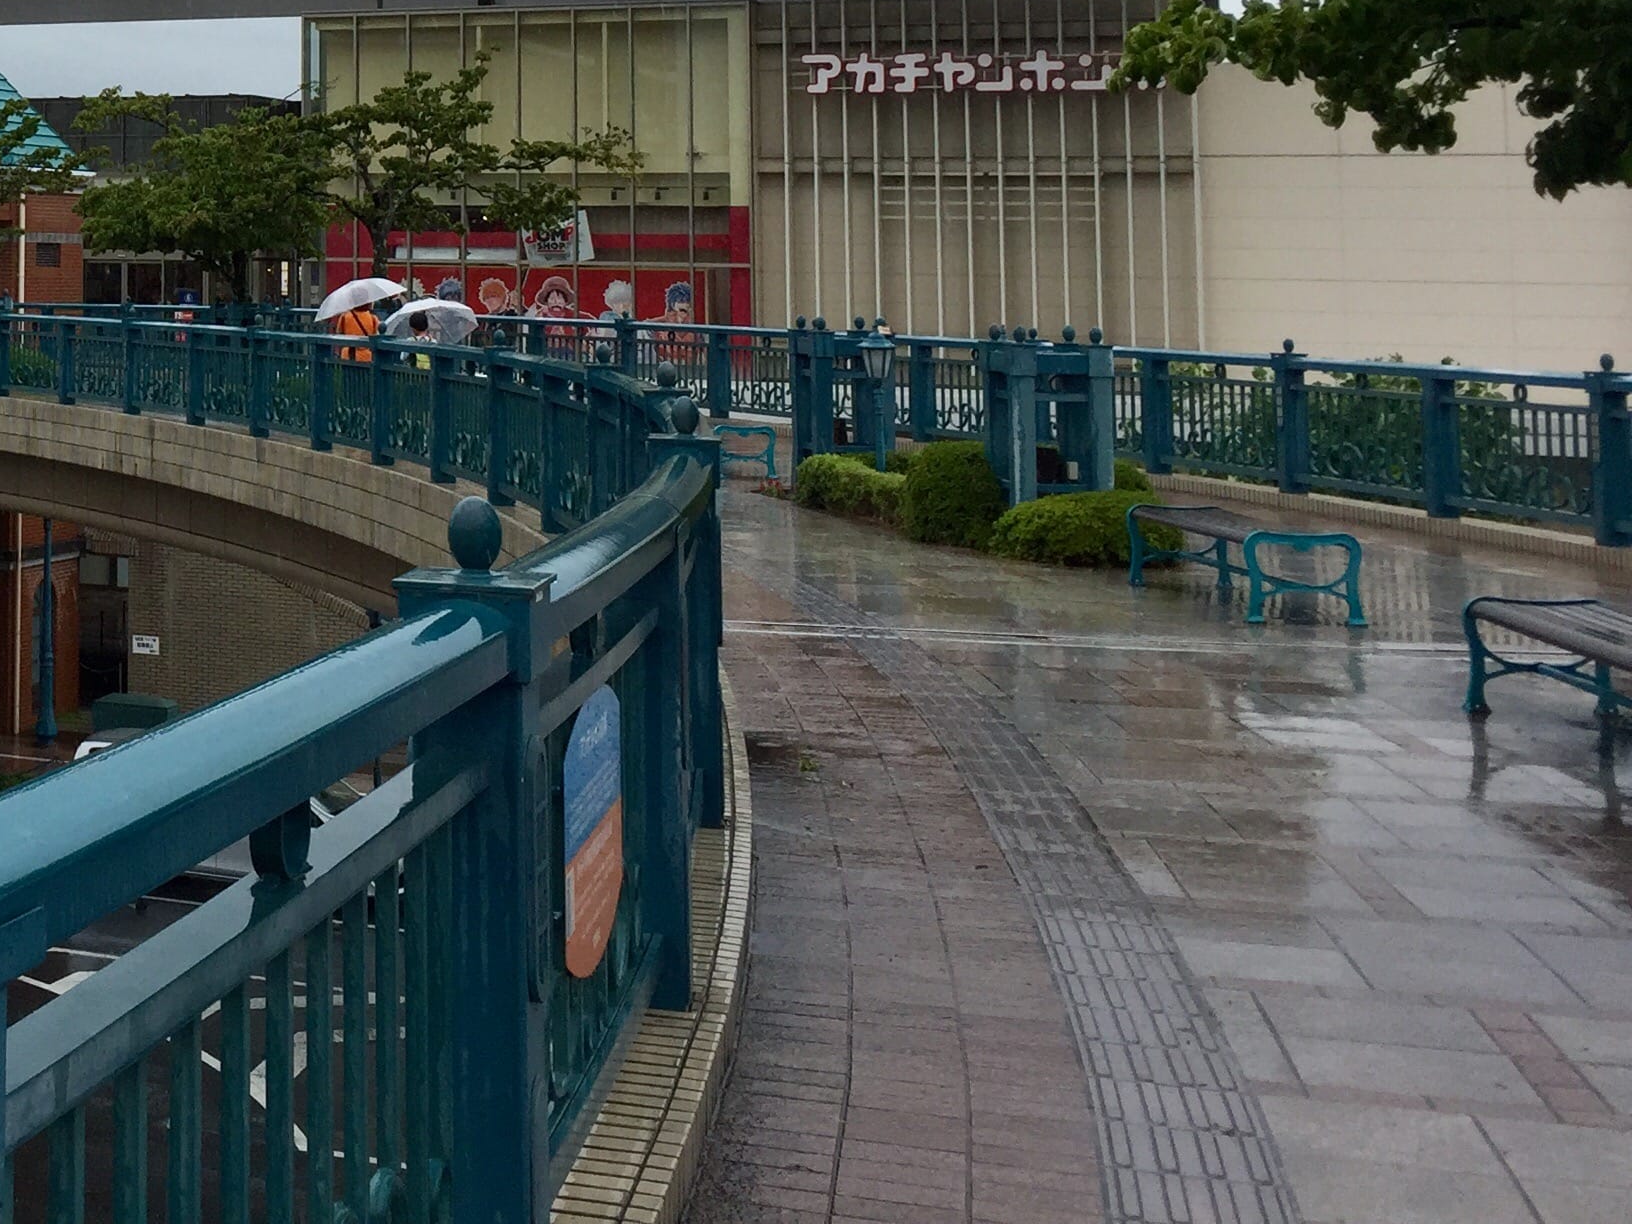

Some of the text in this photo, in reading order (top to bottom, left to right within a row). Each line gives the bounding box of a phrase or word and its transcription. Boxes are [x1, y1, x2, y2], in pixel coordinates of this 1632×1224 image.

[801, 49, 1167, 93] アカチャンホン
[536, 242, 566, 251] SHOP
